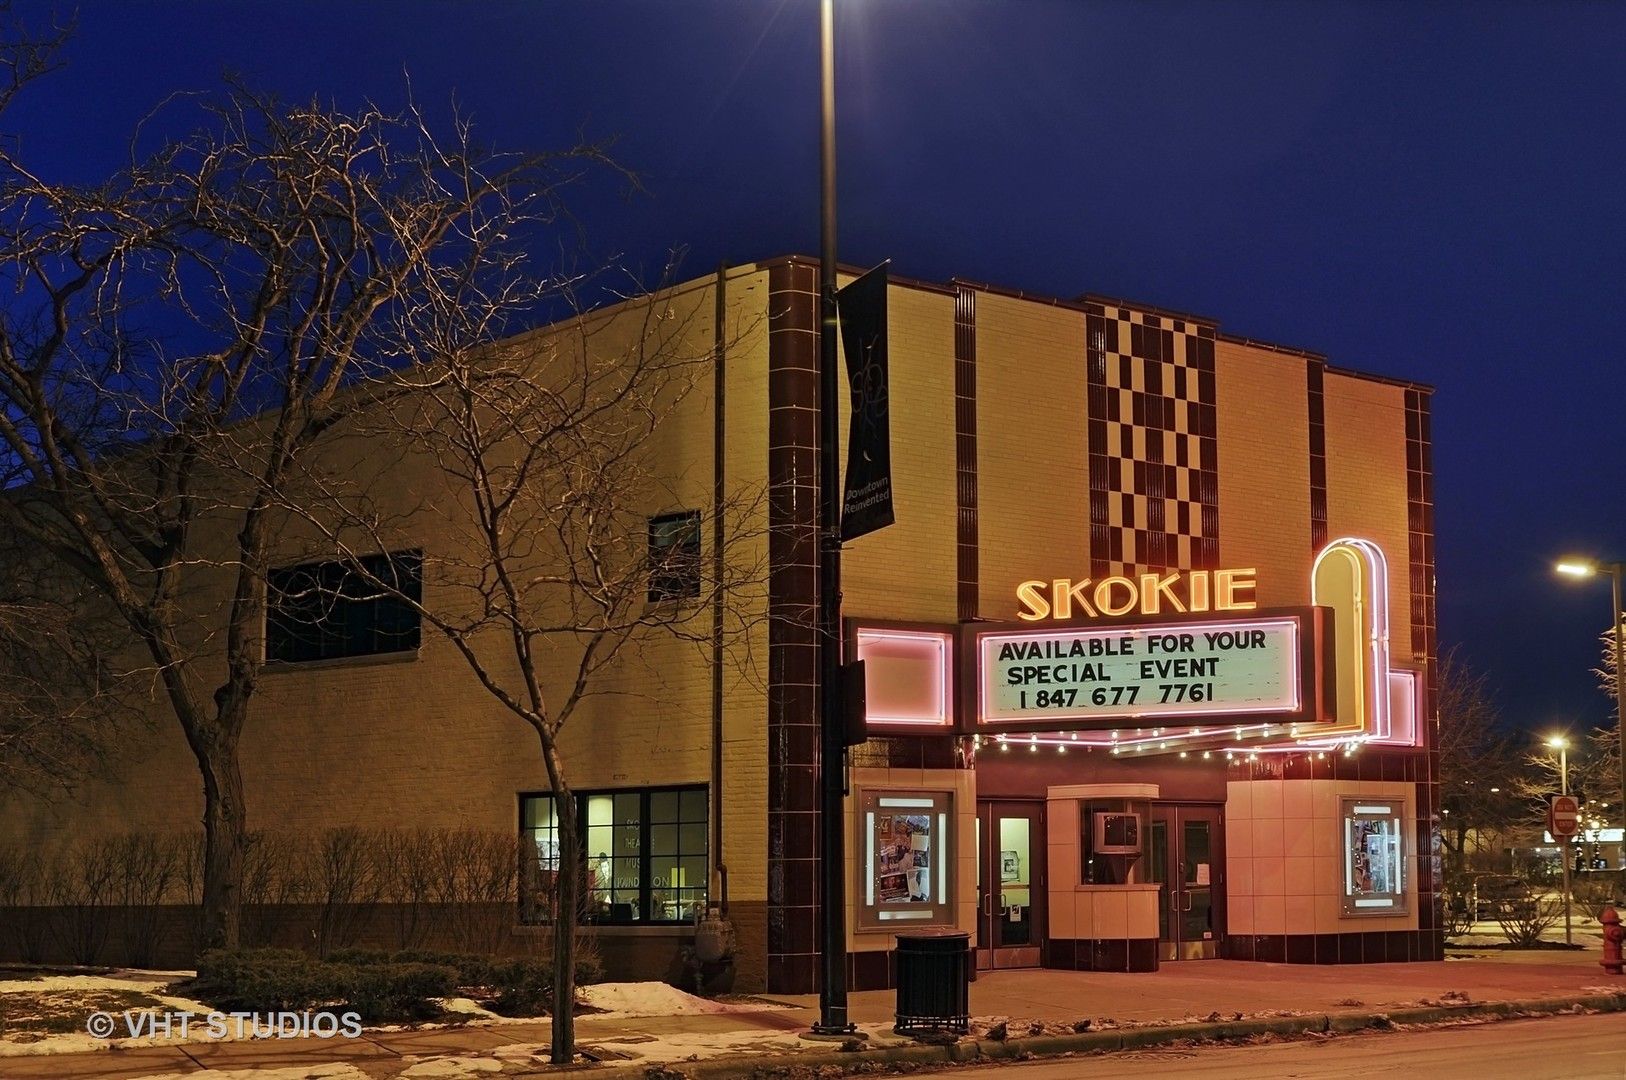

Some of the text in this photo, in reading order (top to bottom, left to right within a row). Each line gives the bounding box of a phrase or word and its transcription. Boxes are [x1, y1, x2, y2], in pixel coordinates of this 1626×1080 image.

[845, 488, 889, 514] Reinvented
[847, 477, 888, 500] Downtown
[1016, 567, 1257, 621] SKOKIE
[998, 630, 1266, 661] AVAILABLE FOR YOUR
[1007, 657, 1220, 685] SPECIAL EVENT
[1036, 688, 1078, 708] 847
[1091, 685, 1141, 706] 677
[1158, 682, 1213, 704] 7761
